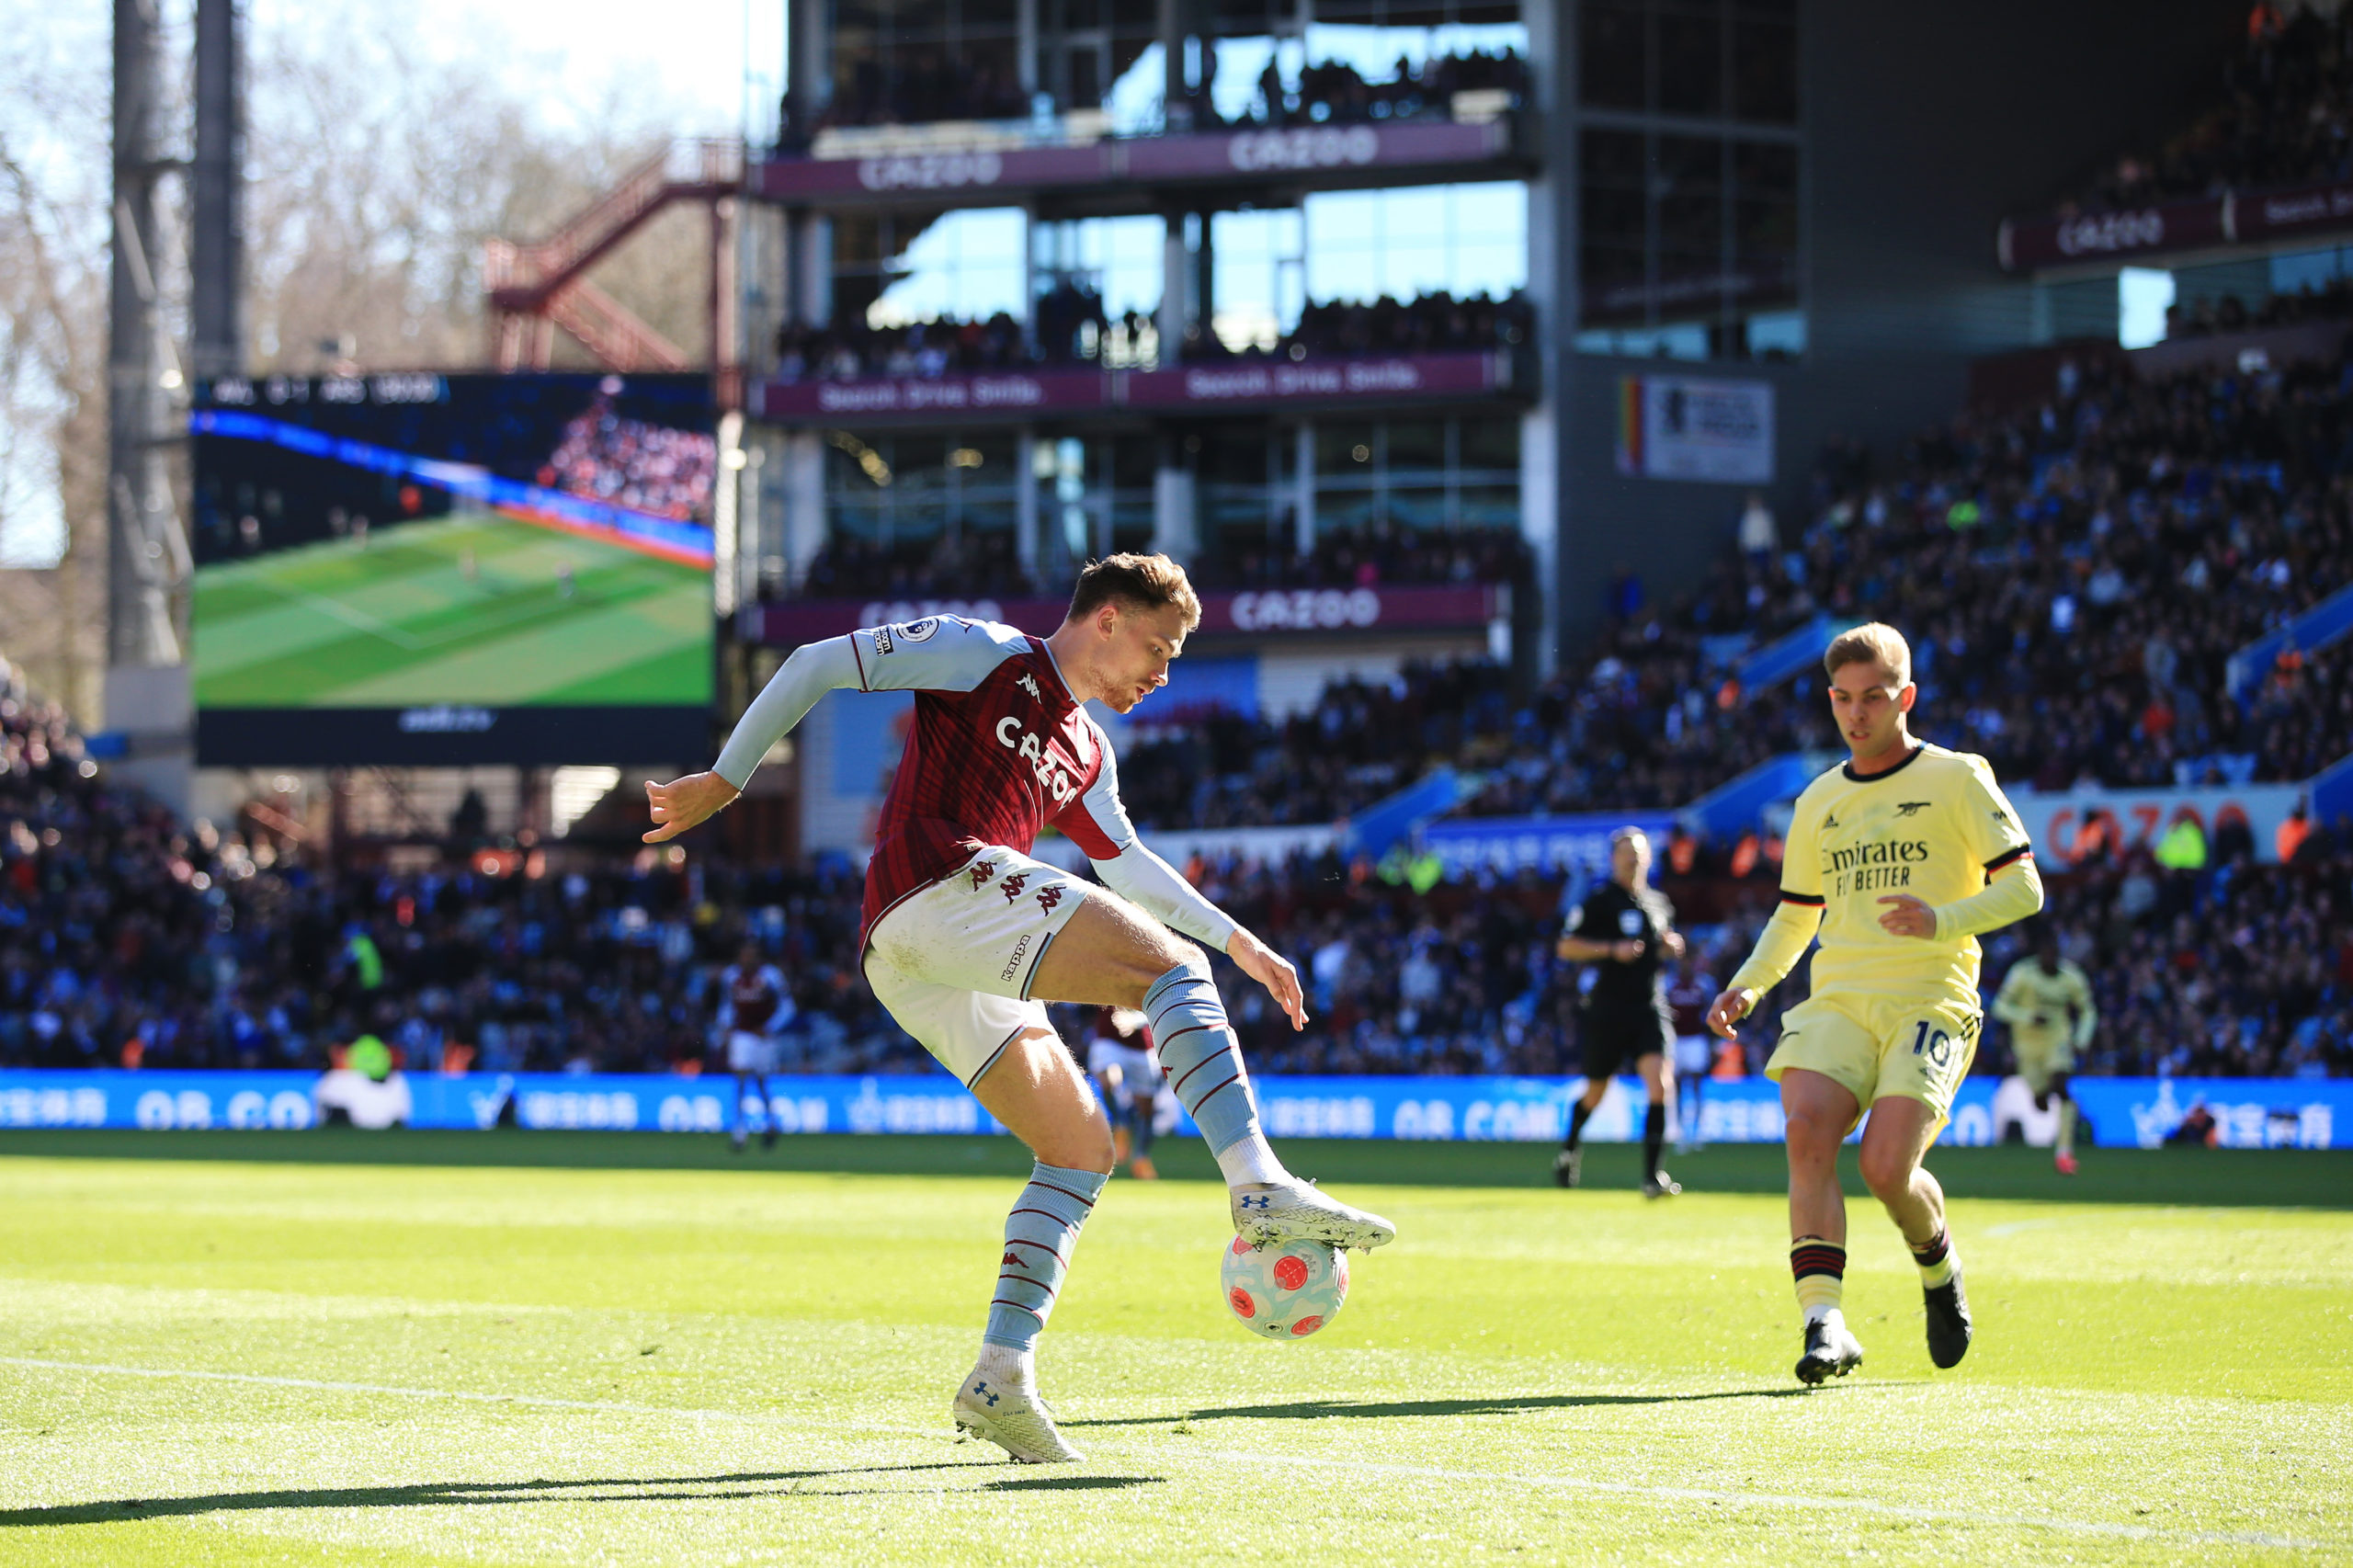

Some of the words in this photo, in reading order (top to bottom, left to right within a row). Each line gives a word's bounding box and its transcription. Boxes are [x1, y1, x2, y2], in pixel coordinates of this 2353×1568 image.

[1229, 127, 1377, 172] CAZOO
[1230, 588, 1381, 631] CAZOO
[1855, 867, 1910, 891] BETTER
[1001, 934, 1030, 982] Kappa
[1913, 1020, 1950, 1067] 10
